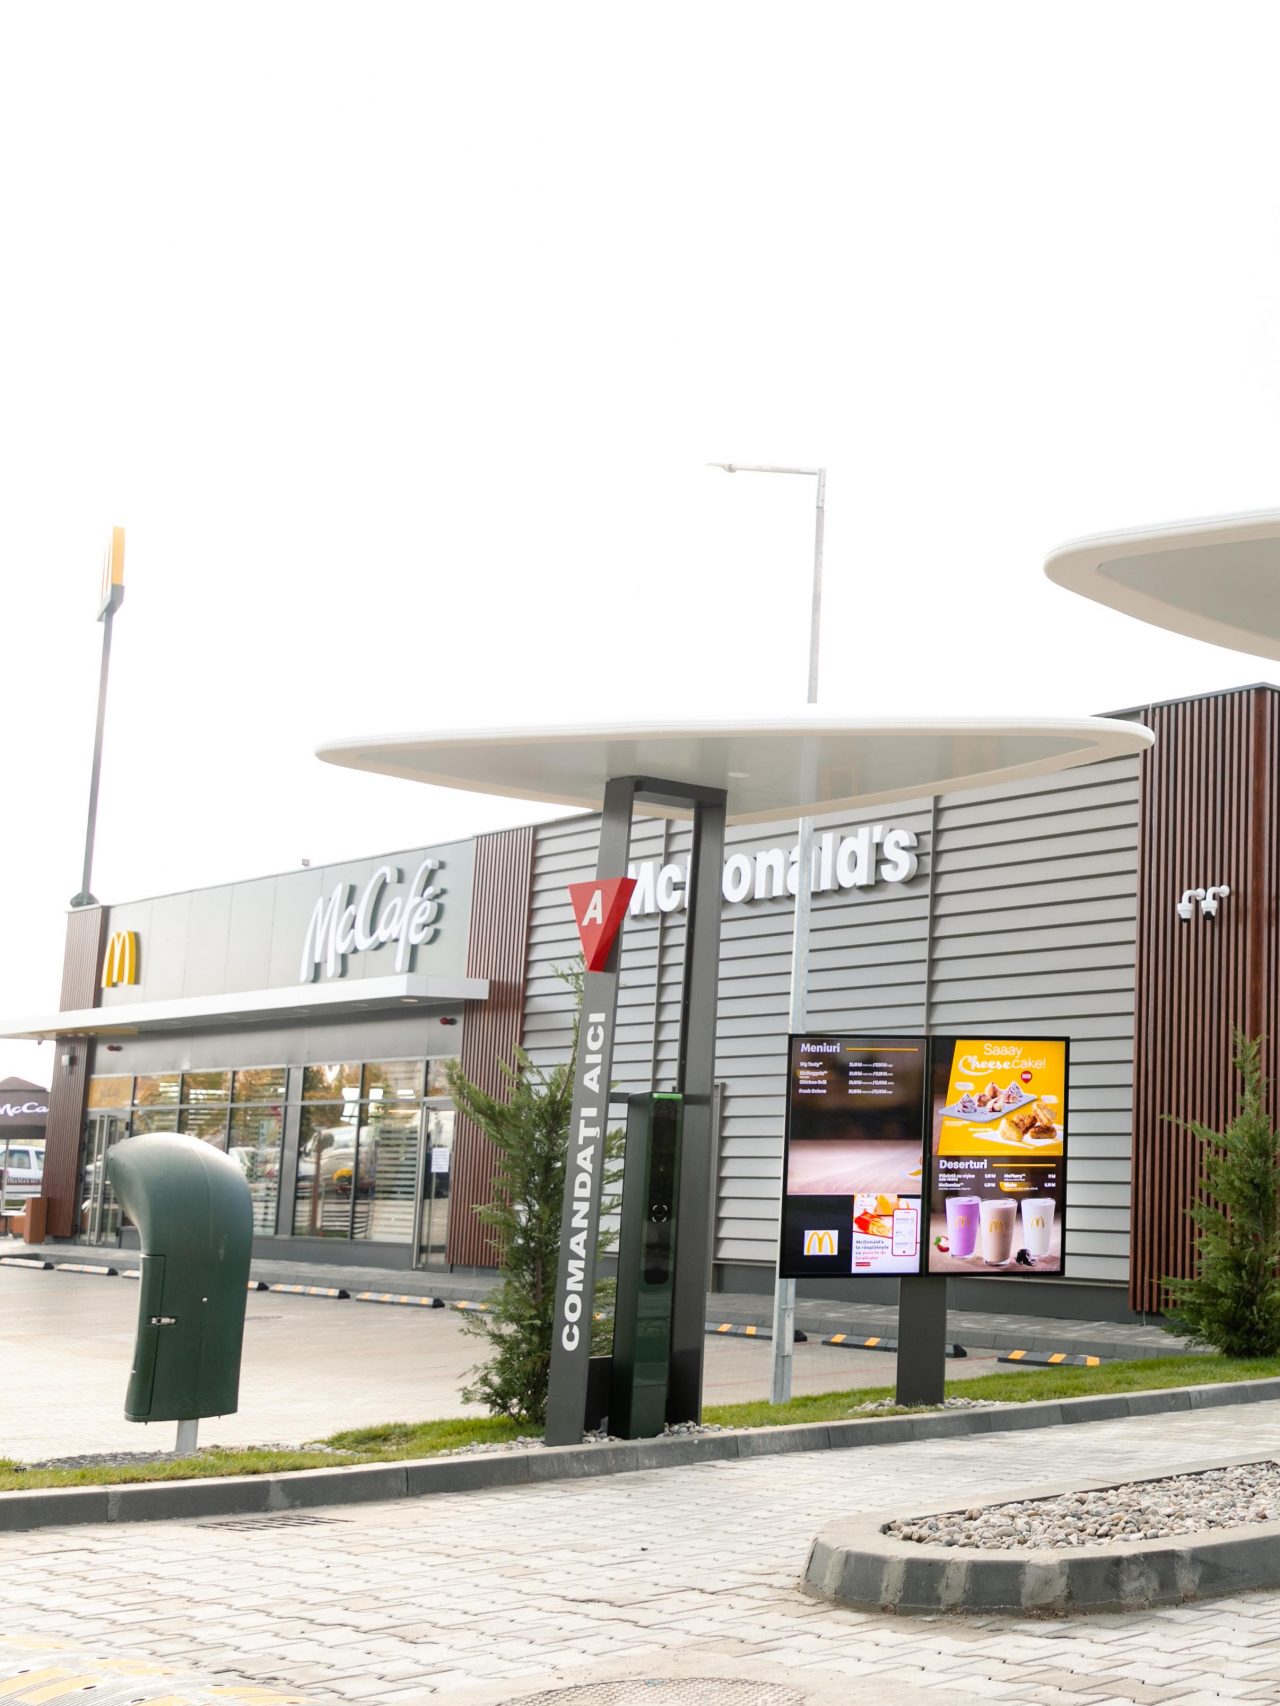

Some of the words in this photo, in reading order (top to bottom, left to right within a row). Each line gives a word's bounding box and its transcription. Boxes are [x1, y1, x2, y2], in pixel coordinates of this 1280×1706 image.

[627, 825, 919, 915] Mconald's
[300, 858, 440, 983] McCafé
[582, 890, 603, 926] A
[583, 1012, 606, 1094] AICI
[800, 1042, 841, 1054] Meniuri
[983, 1043, 1023, 1058] Saaay
[0, 1101, 49, 1117] McCa
[939, 1158, 988, 1169] Deserturi
